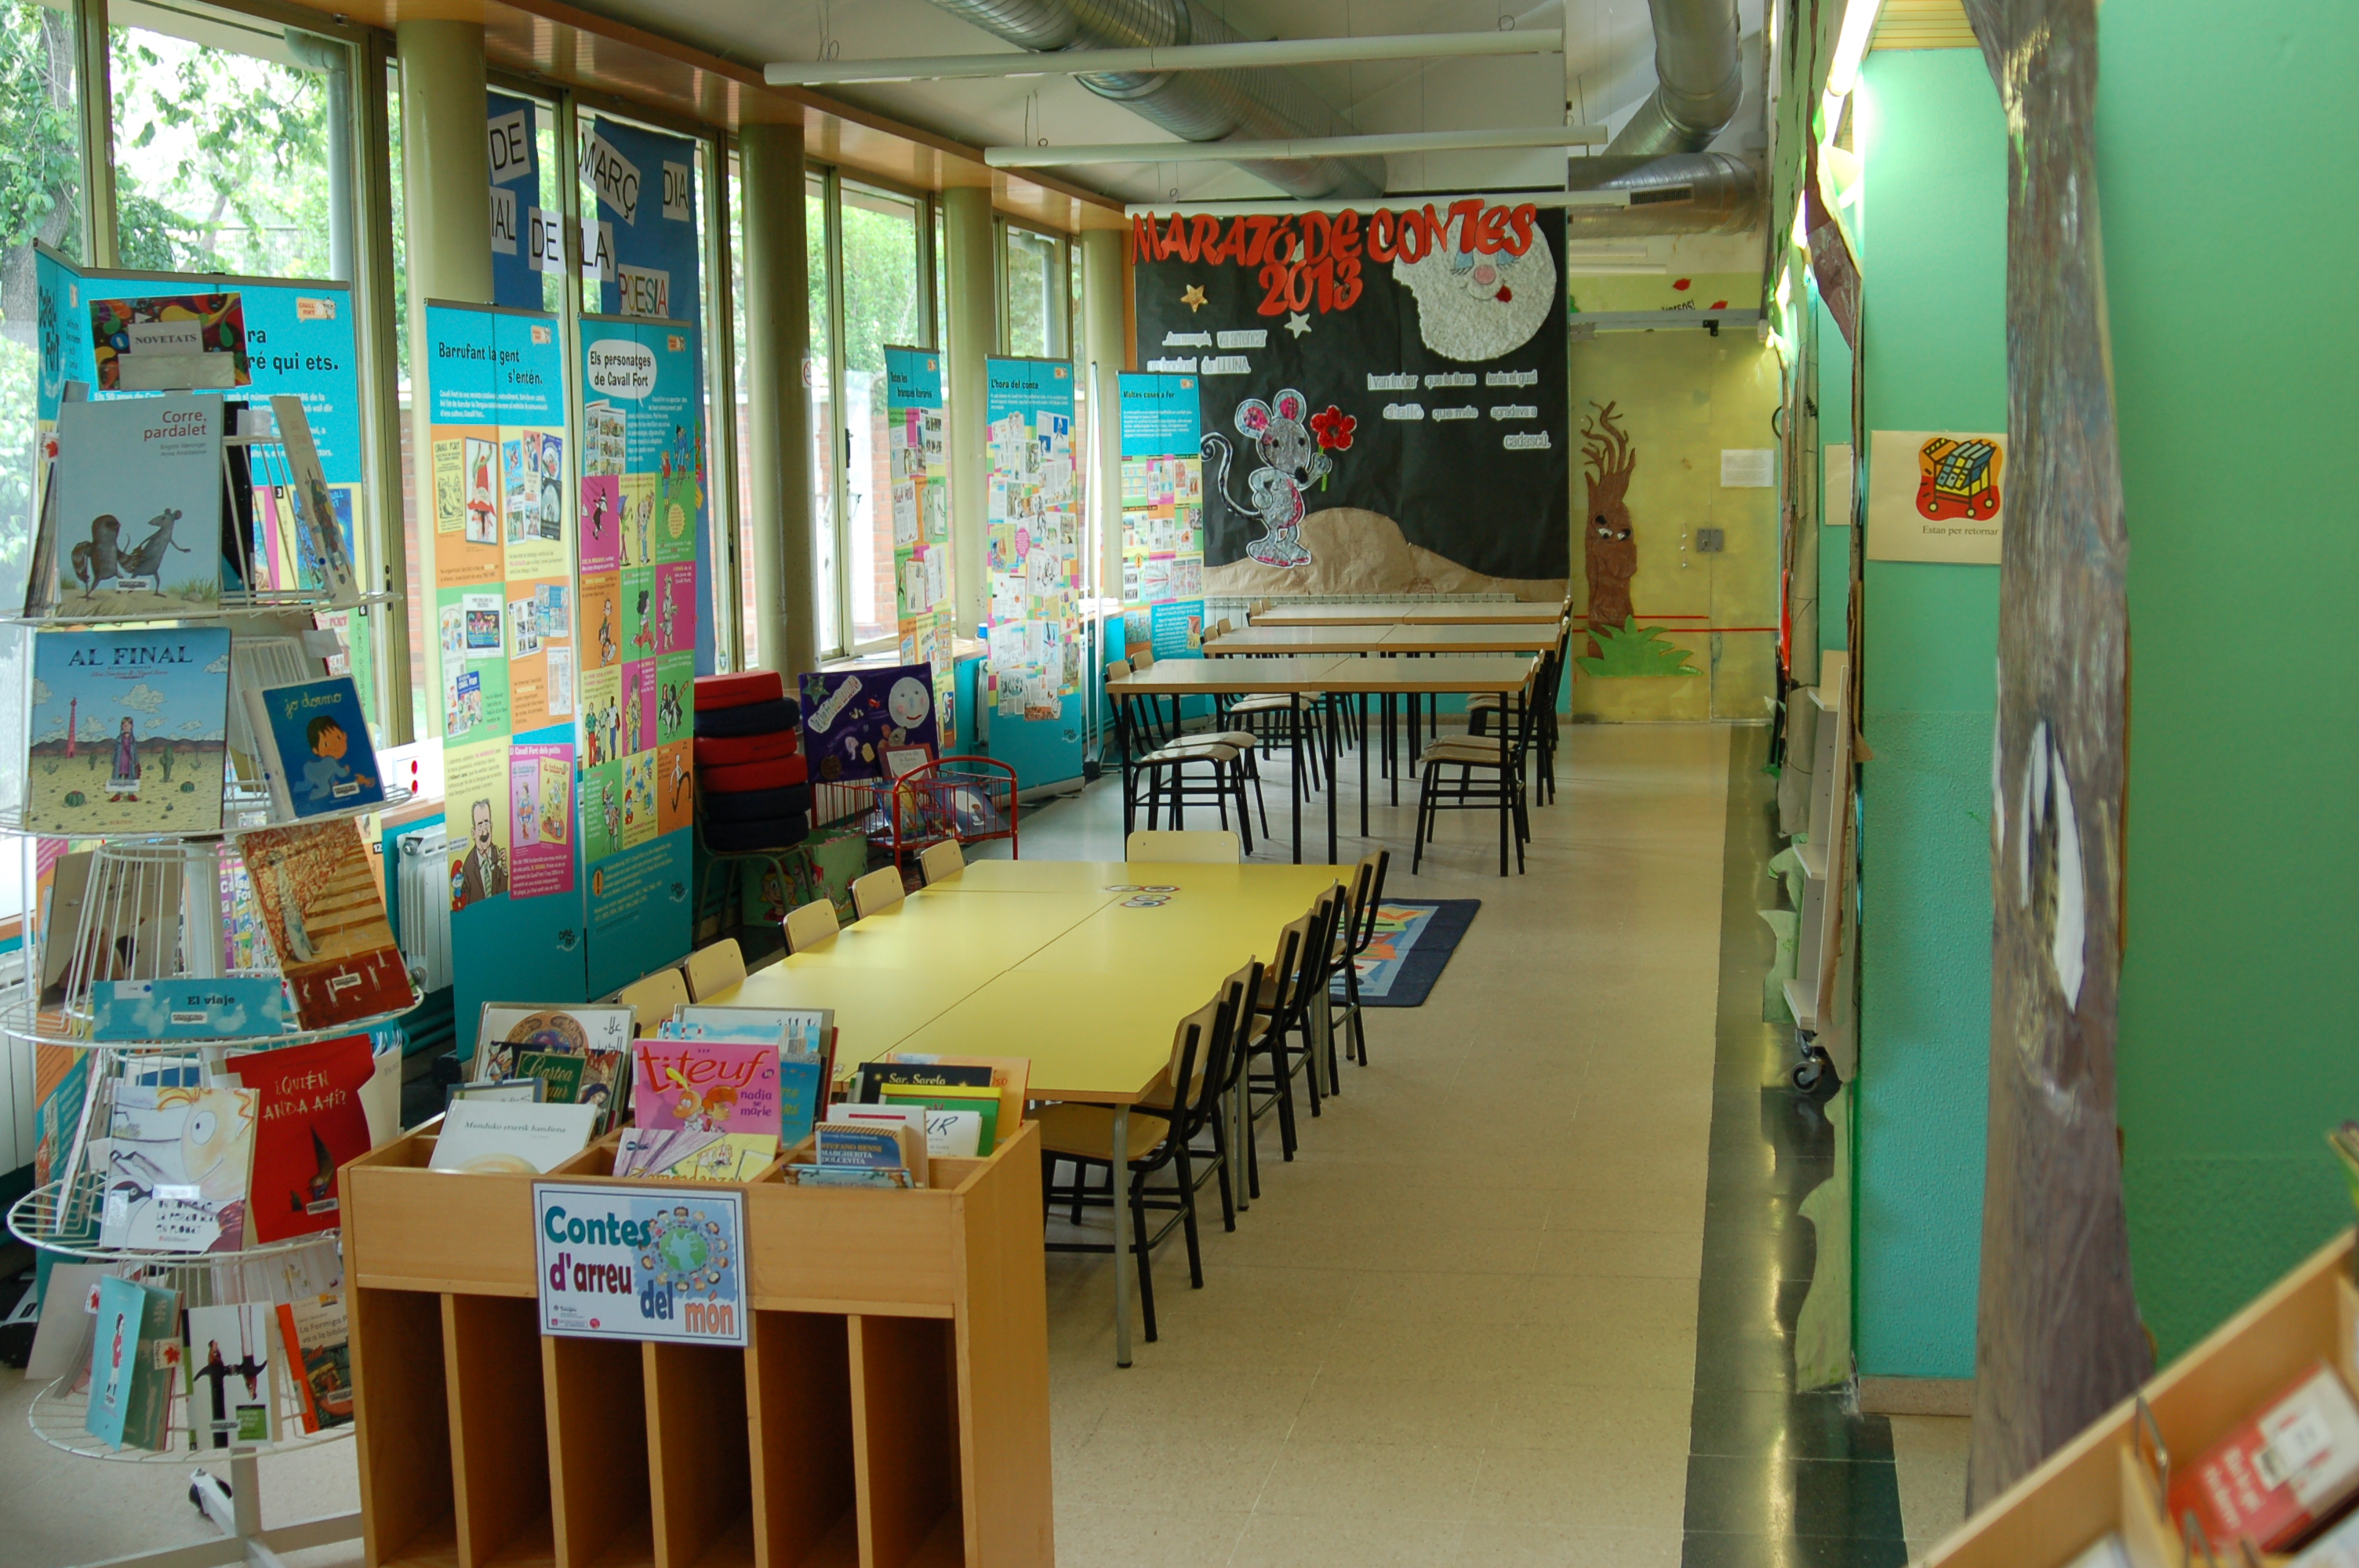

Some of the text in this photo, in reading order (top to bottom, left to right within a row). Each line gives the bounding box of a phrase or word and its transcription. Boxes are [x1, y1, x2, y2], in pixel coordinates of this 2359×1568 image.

[489, 122, 689, 220] DE MARÇ DIA
[532, 217, 558, 261] DE
[1132, 198, 1536, 266] MARATÓ DE CONTES
[619, 271, 668, 314] POESIA
[1257, 258, 1363, 315] 2013
[136, 334, 197, 345] NOVETATS
[438, 342, 520, 365] Barrufant la gent
[590, 351, 651, 370] Els personatges
[273, 352, 299, 375] qui
[306, 354, 339, 370] ets.
[507, 368, 543, 384] s'entén.
[594, 372, 649, 387] de Cavall Fort
[991, 379, 1009, 389] L'hora
[1012, 379, 1020, 389] del
[1374, 376, 1390, 388] van
[1391, 373, 1418, 388] trobar
[1426, 376, 1442, 389] que
[1445, 373, 1452, 385] la
[1454, 372, 1475, 384] lluna
[1487, 372, 1507, 384] tenia
[1509, 371, 1517, 383] el
[1518, 370, 1537, 387] gust
[162, 411, 206, 423] Corre,
[1433, 409, 1452, 422] que
[1455, 406, 1478, 417] més
[1491, 405, 1530, 420] agradava
[144, 423, 206, 441] pardalet
[1504, 431, 1550, 448] cadascú.
[277, 488, 282, 497] 3
[1922, 525, 1999, 537] Estan per retornar
[360, 606, 365, 615] 6
[68, 645, 193, 666] AL FINAL
[373, 844, 383, 853] 12
[187, 996, 235, 1006] El viaje
[522, 1053, 574, 1081] Cartea
[638, 1046, 769, 1094] titeuf
[275, 1069, 329, 1096] ¿QUIÉN
[740, 1089, 772, 1100] nadia
[263, 1088, 347, 1122] ANDA AHÍ?
[740, 1106, 772, 1117] marie
[464, 1121, 501, 1130] Munduko
[821, 1149, 873, 1160] MARGHERITA
[544, 1206, 651, 1247] Contes
[550, 1252, 632, 1294] d'arreu
[640, 1279, 674, 1319] del
[685, 1290, 734, 1334] món
[310, 1319, 340, 1330] Formiga
[325, 1327, 347, 1337] biblio
